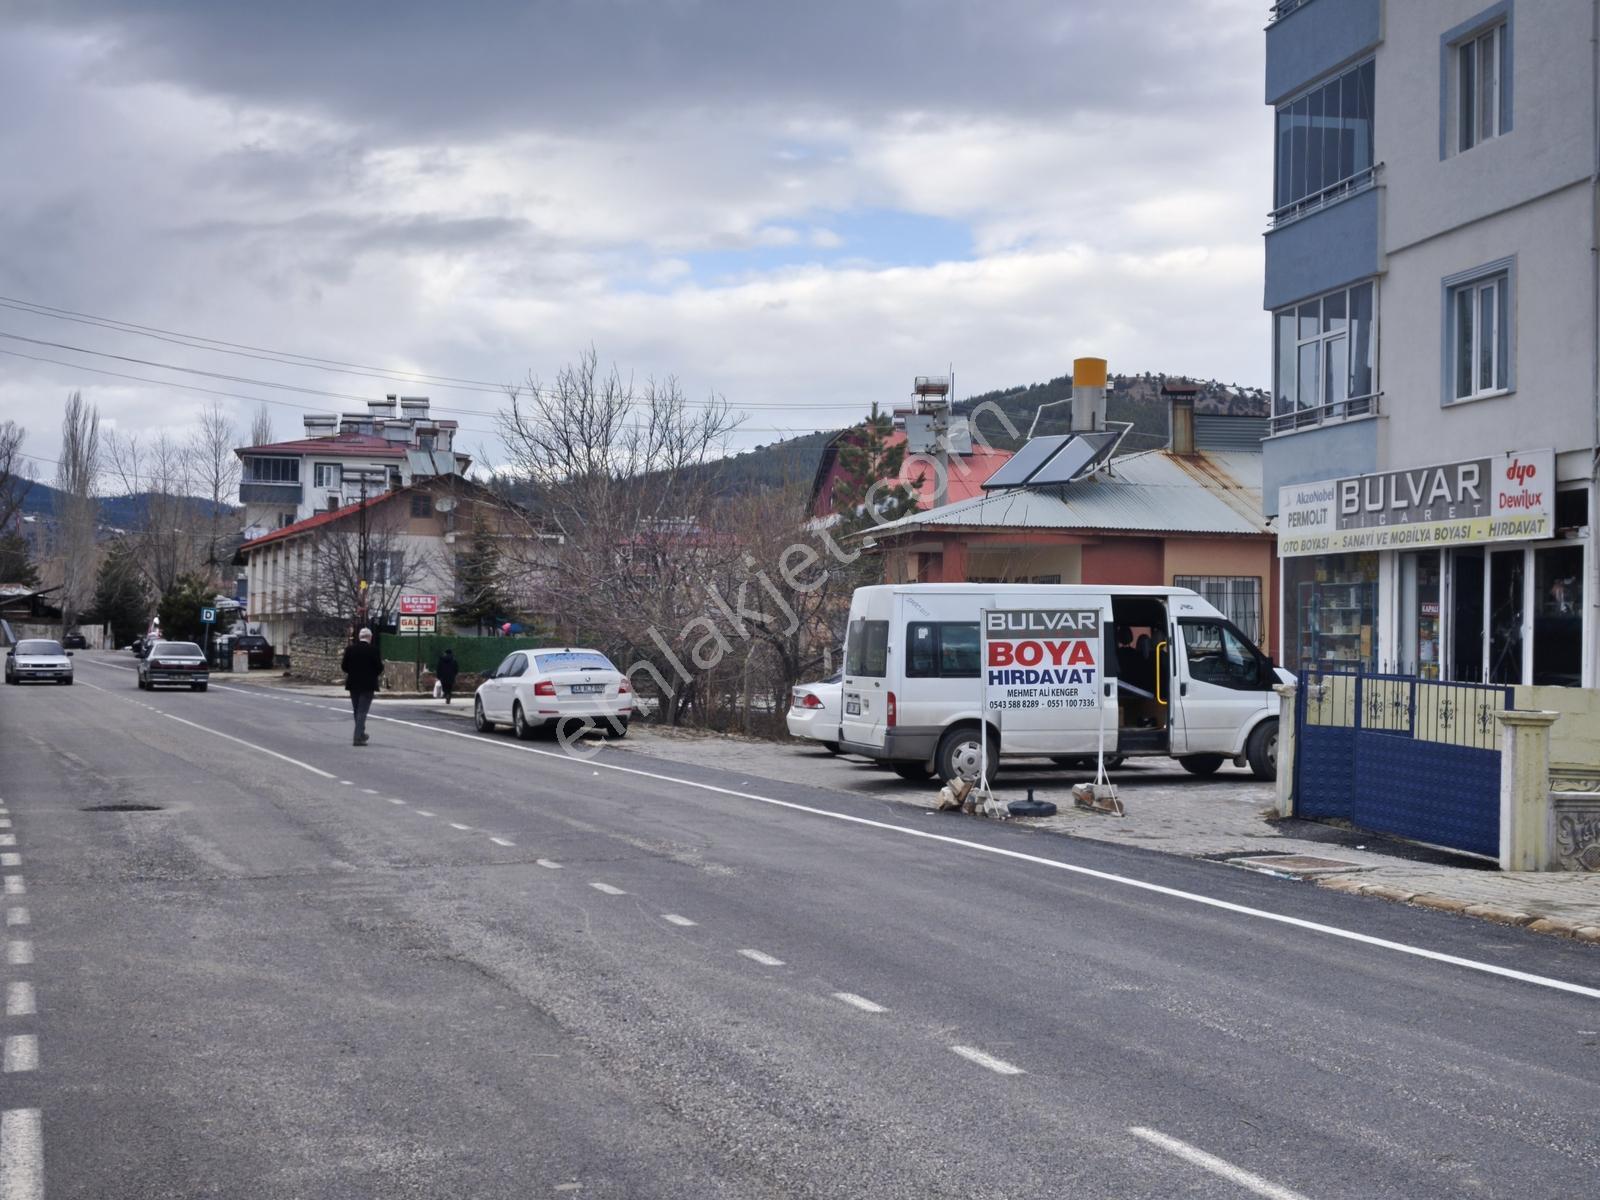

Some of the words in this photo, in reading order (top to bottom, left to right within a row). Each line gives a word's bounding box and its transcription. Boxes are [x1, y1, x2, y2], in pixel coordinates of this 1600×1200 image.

[1506, 459, 1536, 486] dyo
[1341, 463, 1481, 514] BULVAR
[1499, 490, 1542, 509] Dewilux
[1283, 540, 1298, 553] OTO
[1301, 537, 1329, 551] BOYASI
[1376, 532, 1388, 545] VE
[1434, 525, 1471, 541] BOYASI
[1488, 519, 1545, 537] HIRDAVAT
[205, 611, 212, 619] D
[988, 612, 1096, 631] BULVAR
[988, 641, 1095, 667] BOYA
[988, 669, 1095, 686] HIRDAVAT
[1007, 689, 1037, 697] MEHMET
[1051, 688, 1078, 697] KENGER
[989, 700, 1007, 709] 0543
[1008, 700, 1021, 709] 588
[1022, 699, 1039, 708] 8289
[1047, 699, 1063, 708] 0551
[1065, 699, 1078, 708] 100
[1079, 698, 1095, 707] 7336
